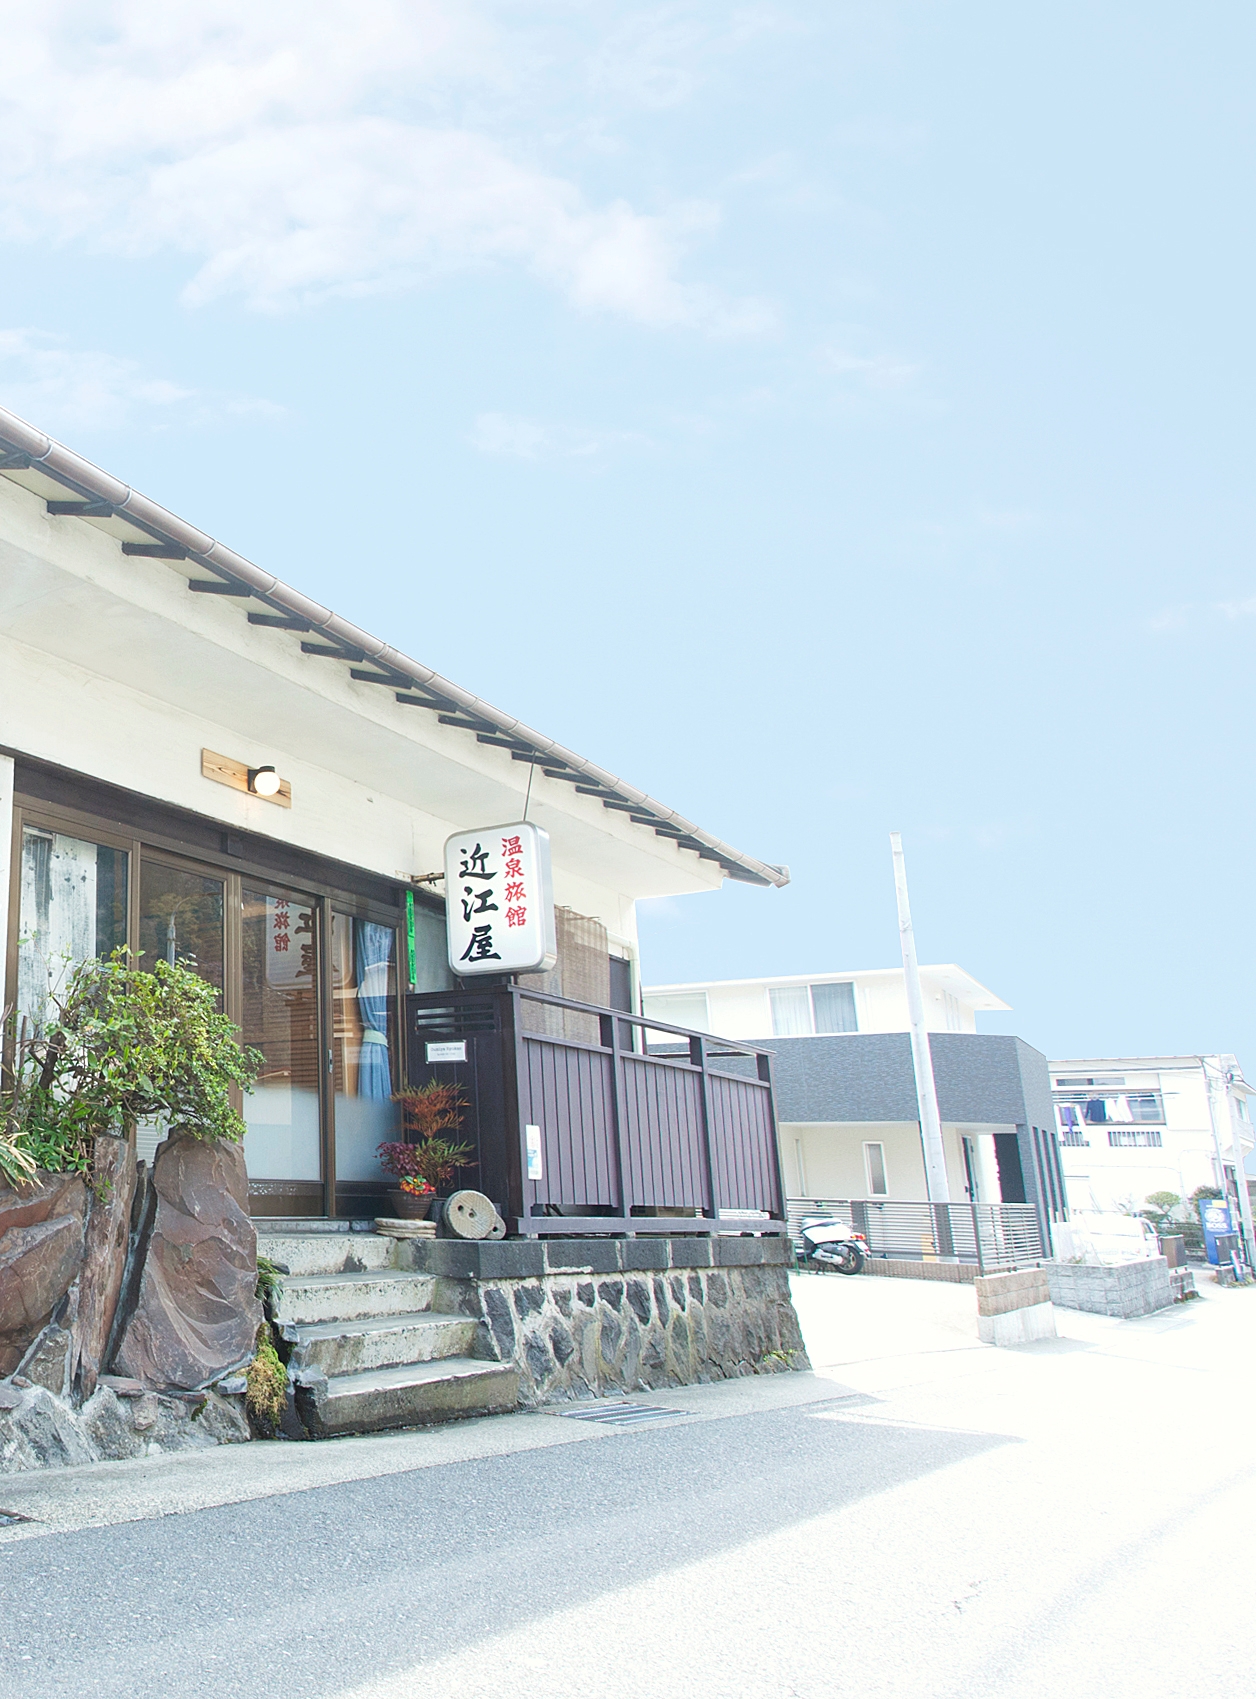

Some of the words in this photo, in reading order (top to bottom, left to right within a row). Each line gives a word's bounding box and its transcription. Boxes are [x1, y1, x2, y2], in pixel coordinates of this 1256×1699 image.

[459, 843, 502, 962] 近江屋
[501, 835, 528, 928] 温泉旅館
